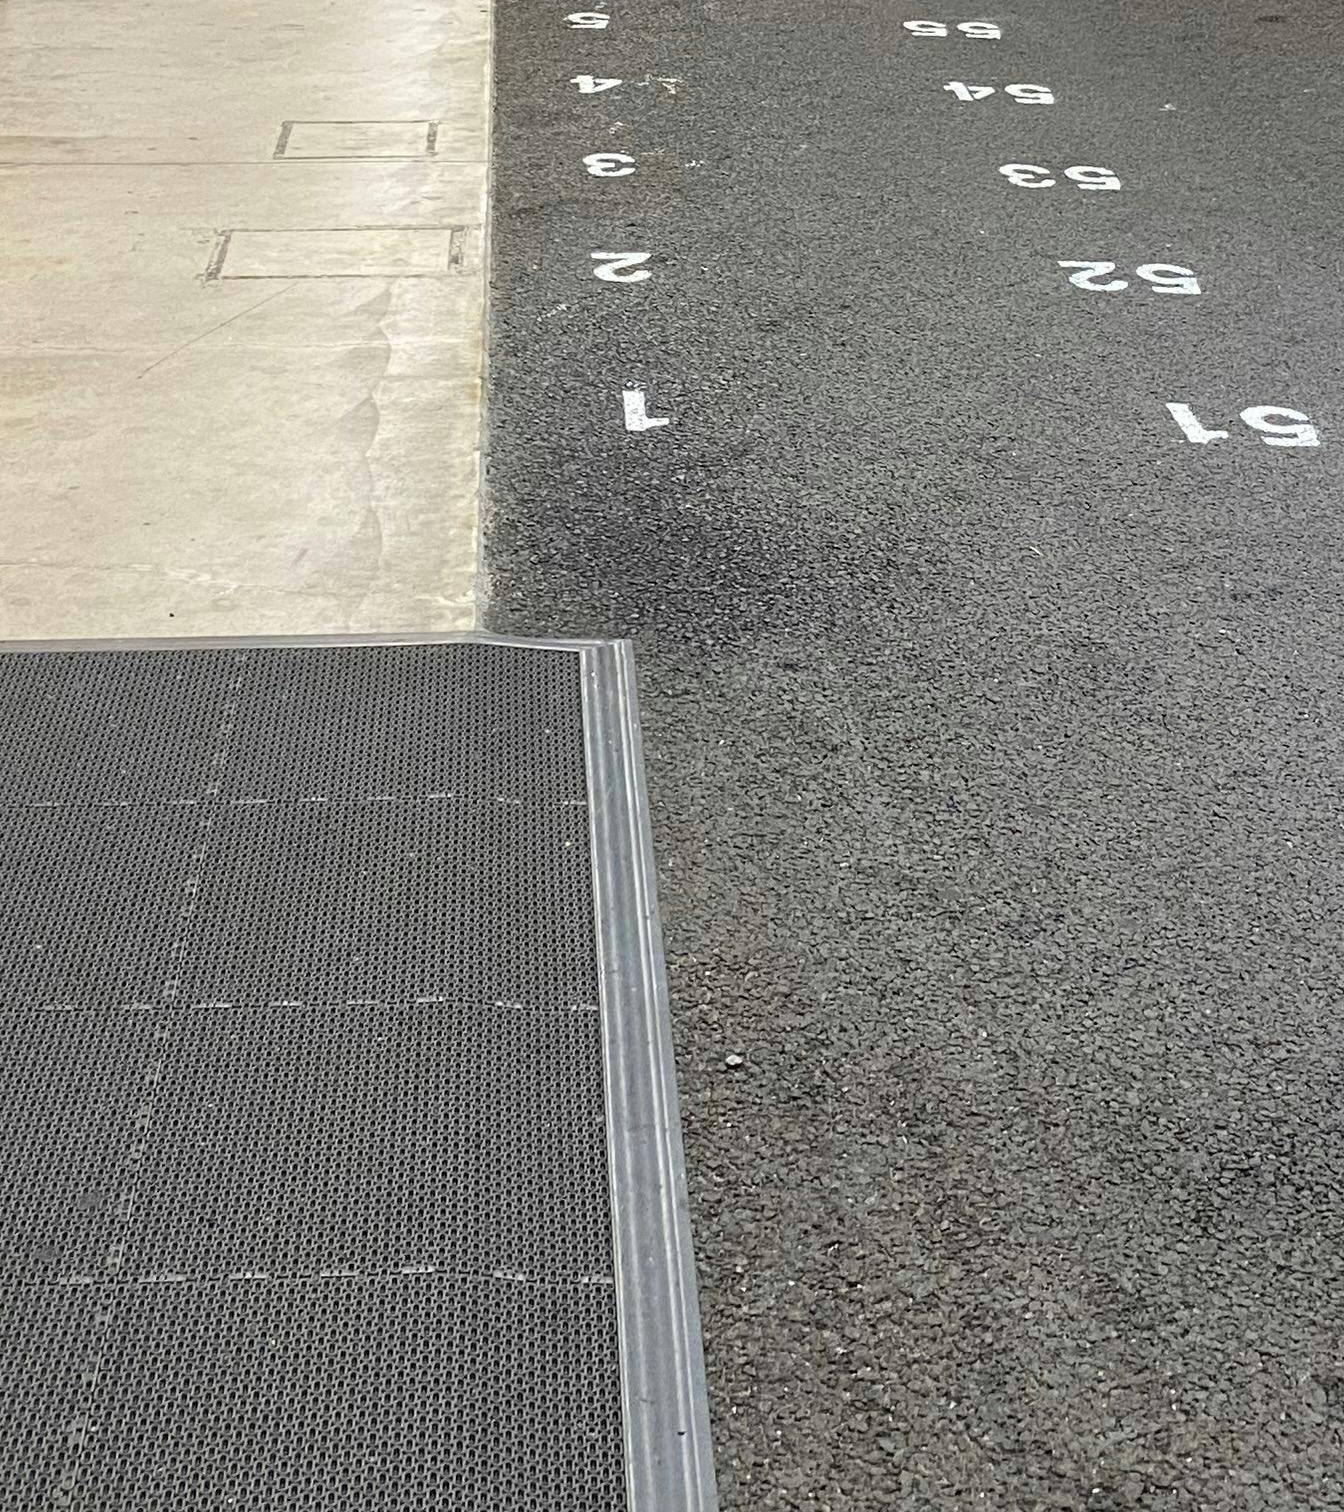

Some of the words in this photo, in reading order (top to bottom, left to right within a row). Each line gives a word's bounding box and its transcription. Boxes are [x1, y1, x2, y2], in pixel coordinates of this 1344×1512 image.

[562, 12, 611, 29] 5
[902, 20, 1002, 40] 55
[569, 74, 623, 94] 4
[943, 81, 1055, 105] 54
[582, 152, 636, 177] 3
[998, 163, 1122, 191] 53
[590, 251, 653, 283] 2
[1057, 260, 1202, 295] 52
[621, 387, 670, 432] 1
[1165, 402, 1321, 448] 51
